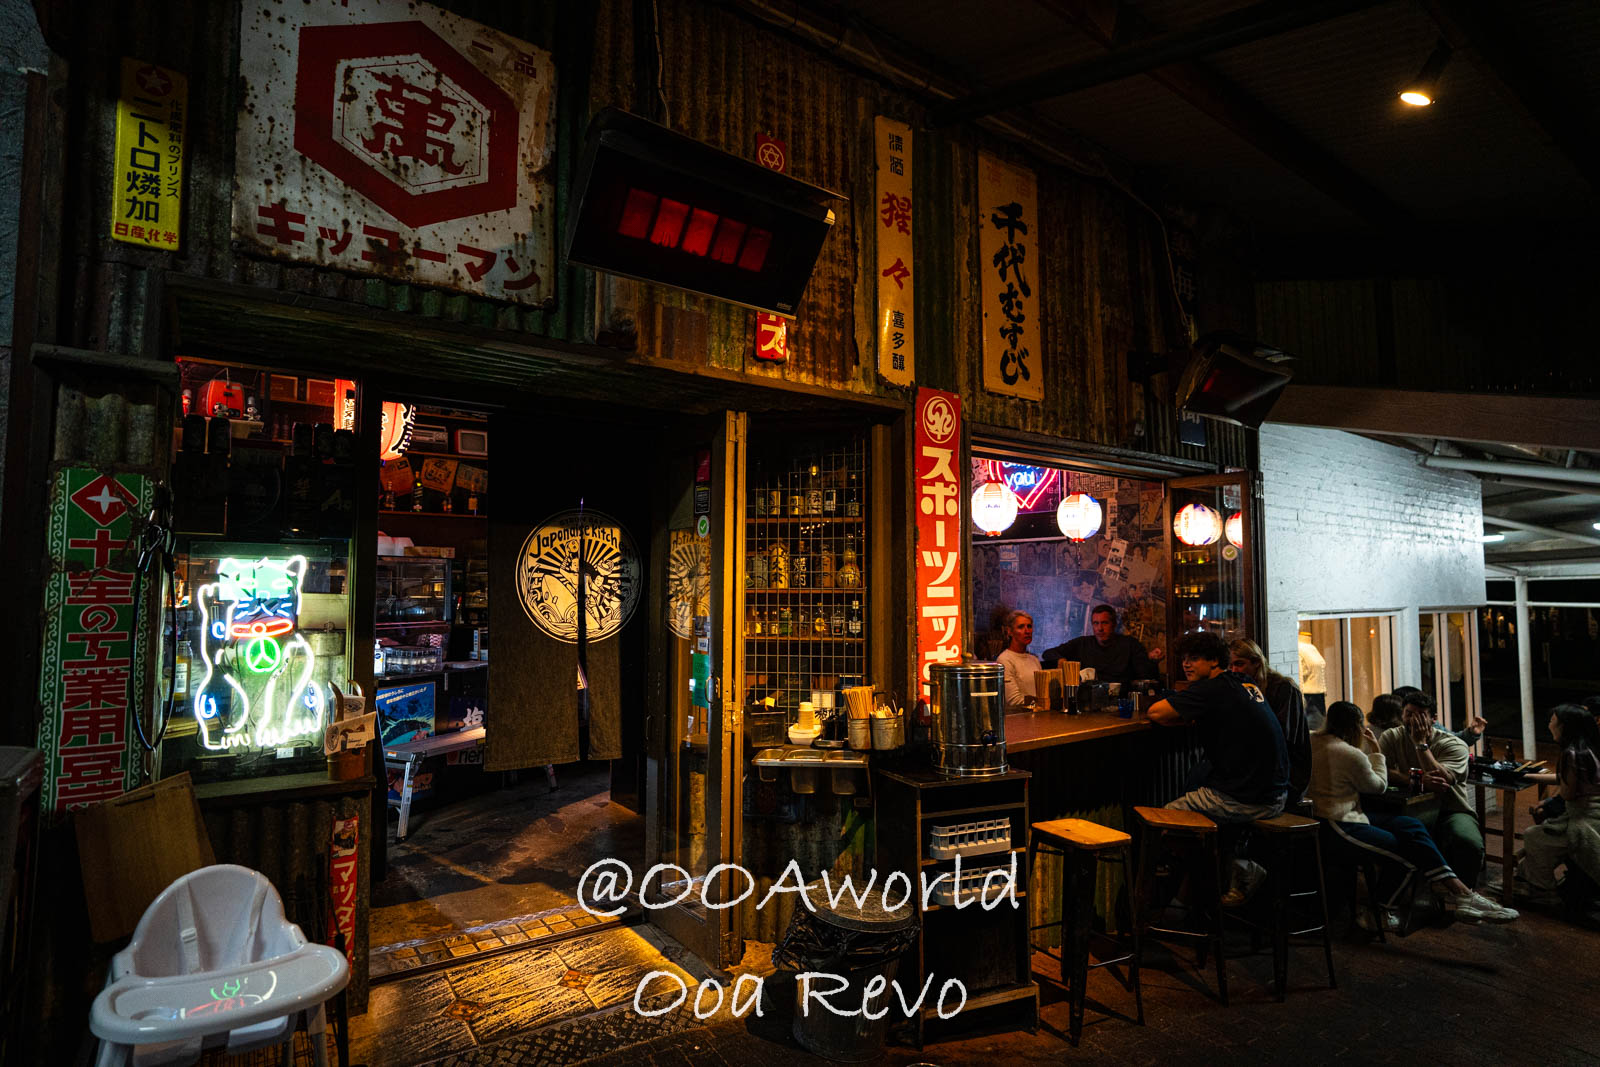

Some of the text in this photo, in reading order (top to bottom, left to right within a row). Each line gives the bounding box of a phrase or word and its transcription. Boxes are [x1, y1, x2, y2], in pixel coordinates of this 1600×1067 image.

[127, 96, 163, 223] ニトロ燐加
[114, 222, 177, 245] 日産化学
[257, 203, 540, 291] キッコーマン
[760, 311, 787, 353] ス
[990, 201, 1031, 386] 千代むすび
[1004, 471, 1036, 491] you
[529, 525, 590, 558] Japonaise
[920, 445, 960, 716] スポーツニッポ
[333, 860, 356, 963] マツダラ
